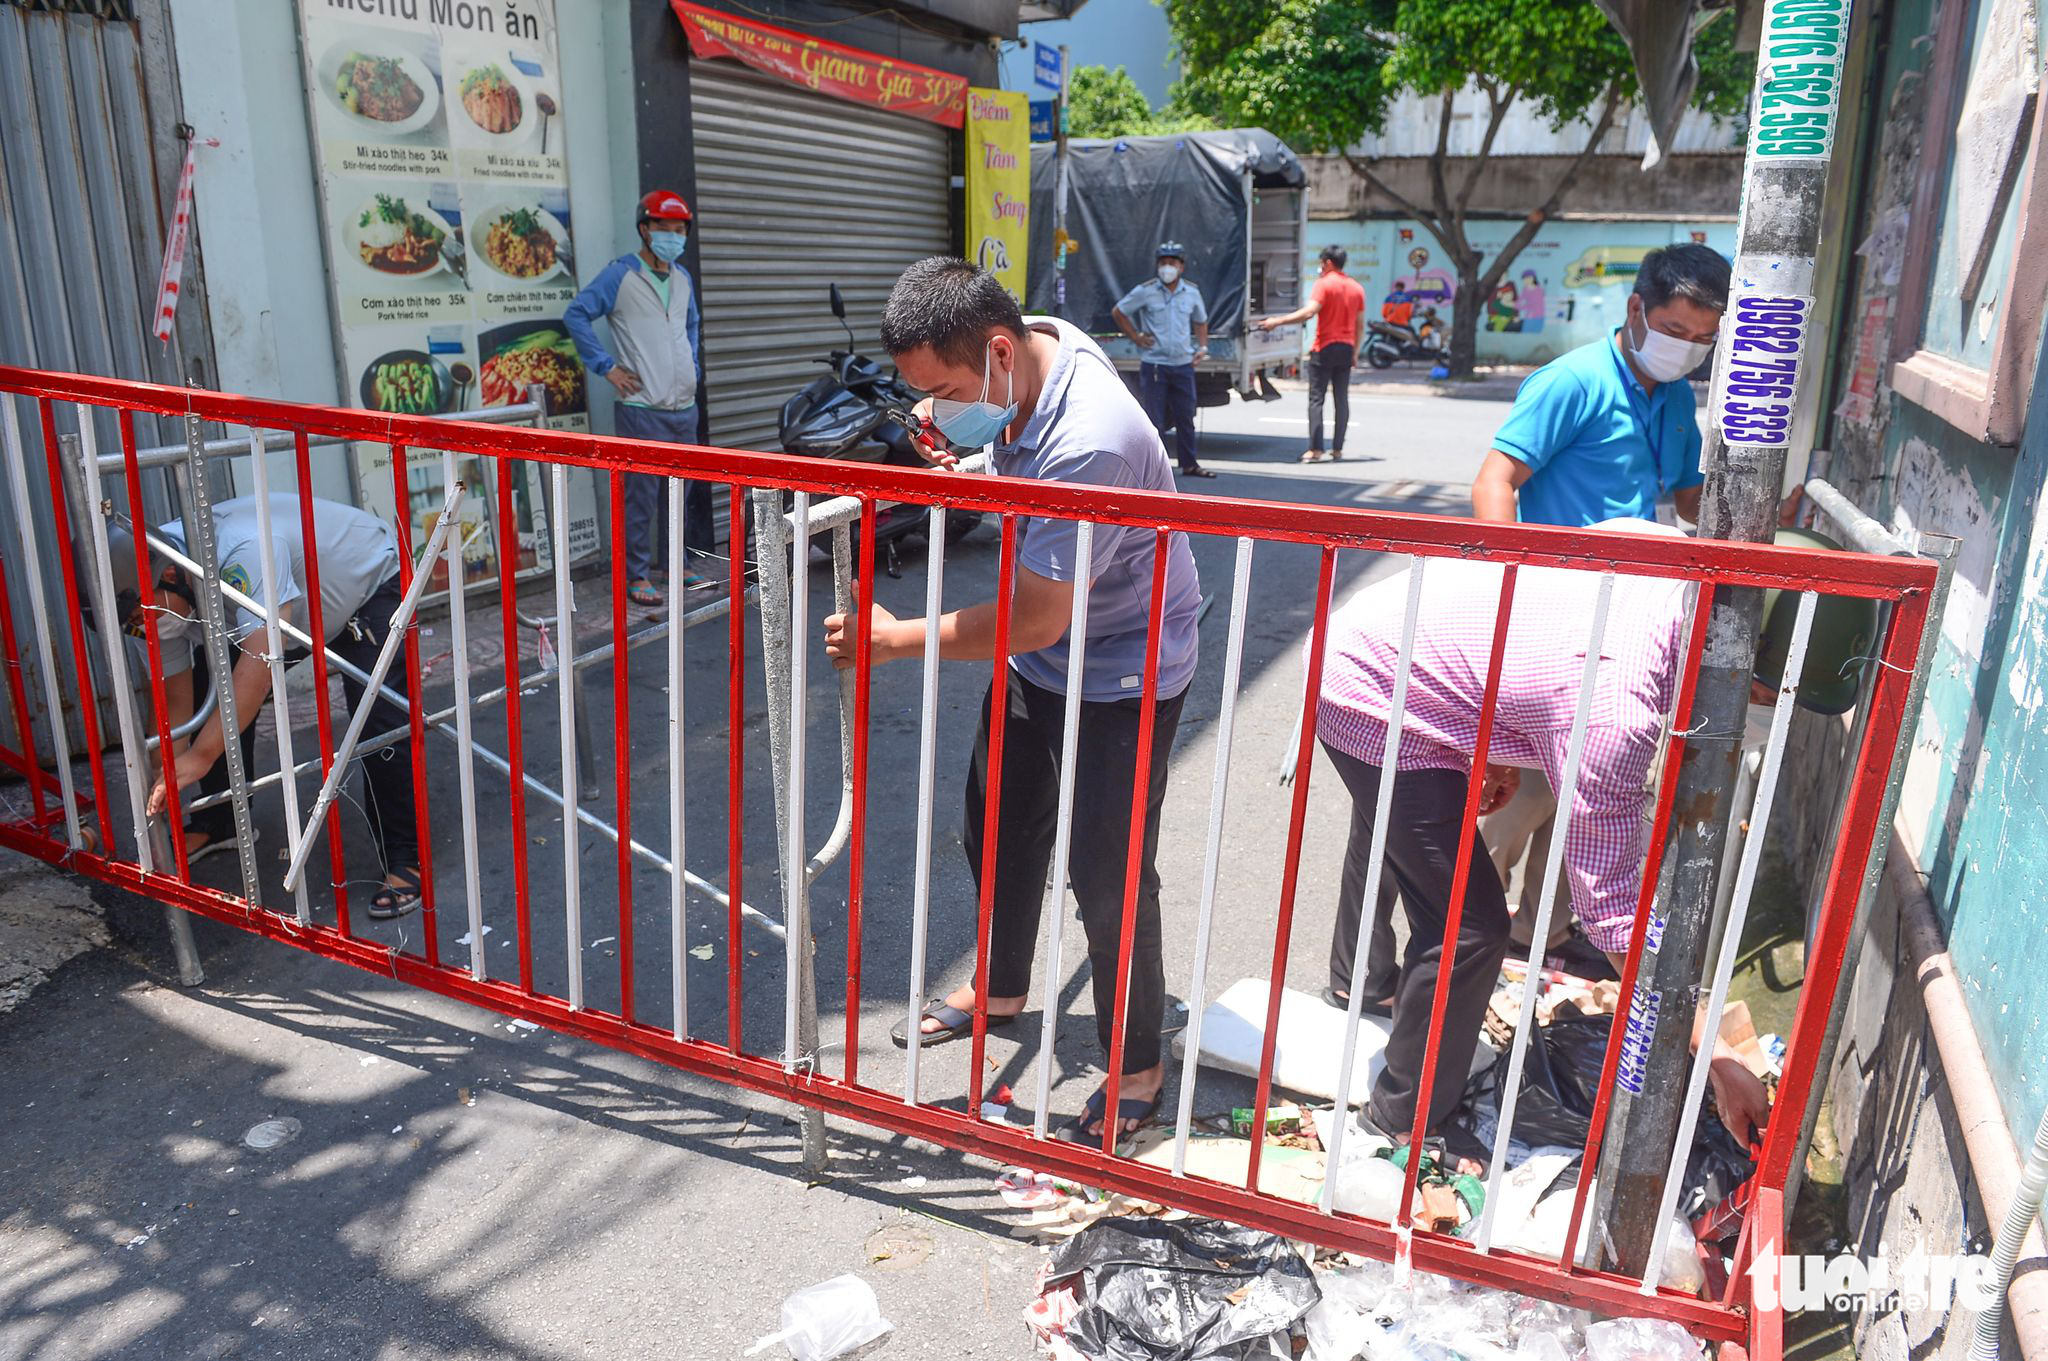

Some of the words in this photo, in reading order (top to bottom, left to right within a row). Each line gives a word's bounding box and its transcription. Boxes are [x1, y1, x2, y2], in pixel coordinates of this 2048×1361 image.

[505, 2, 539, 40] ăn
[920, 72, 964, 112] 30%
[371, 147, 388, 159] xào
[390, 148, 406, 161] thịt
[408, 150, 425, 161] heo
[430, 149, 449, 162] 34k
[985, 143, 1017, 170] Tâm
[343, 160, 376, 171] Stir-fried
[378, 162, 407, 172] noodles
[409, 163, 423, 173] with
[425, 166, 441, 175] pork
[473, 167, 490, 177] Fried
[491, 168, 516, 178] noodles
[517, 169, 530, 178] with
[993, 192, 1027, 228] Sáng
[979, 237, 1009, 275] Cà
[361, 297, 384, 309] Cơm
[387, 296, 404, 308] xào
[406, 295, 421, 309] thịt
[424, 296, 441, 306] heo
[448, 293, 466, 306] 35k
[486, 292, 504, 303] Cơm
[543, 291, 557, 300] heo
[377, 312, 395, 321] Pork
[397, 310, 414, 320] fried
[416, 310, 429, 319] rice
[503, 305, 517, 313] Pork
[518, 304, 531, 313] fried
[532, 304, 543, 312] rice
[1723, 297, 1806, 443] 0982.756.333
